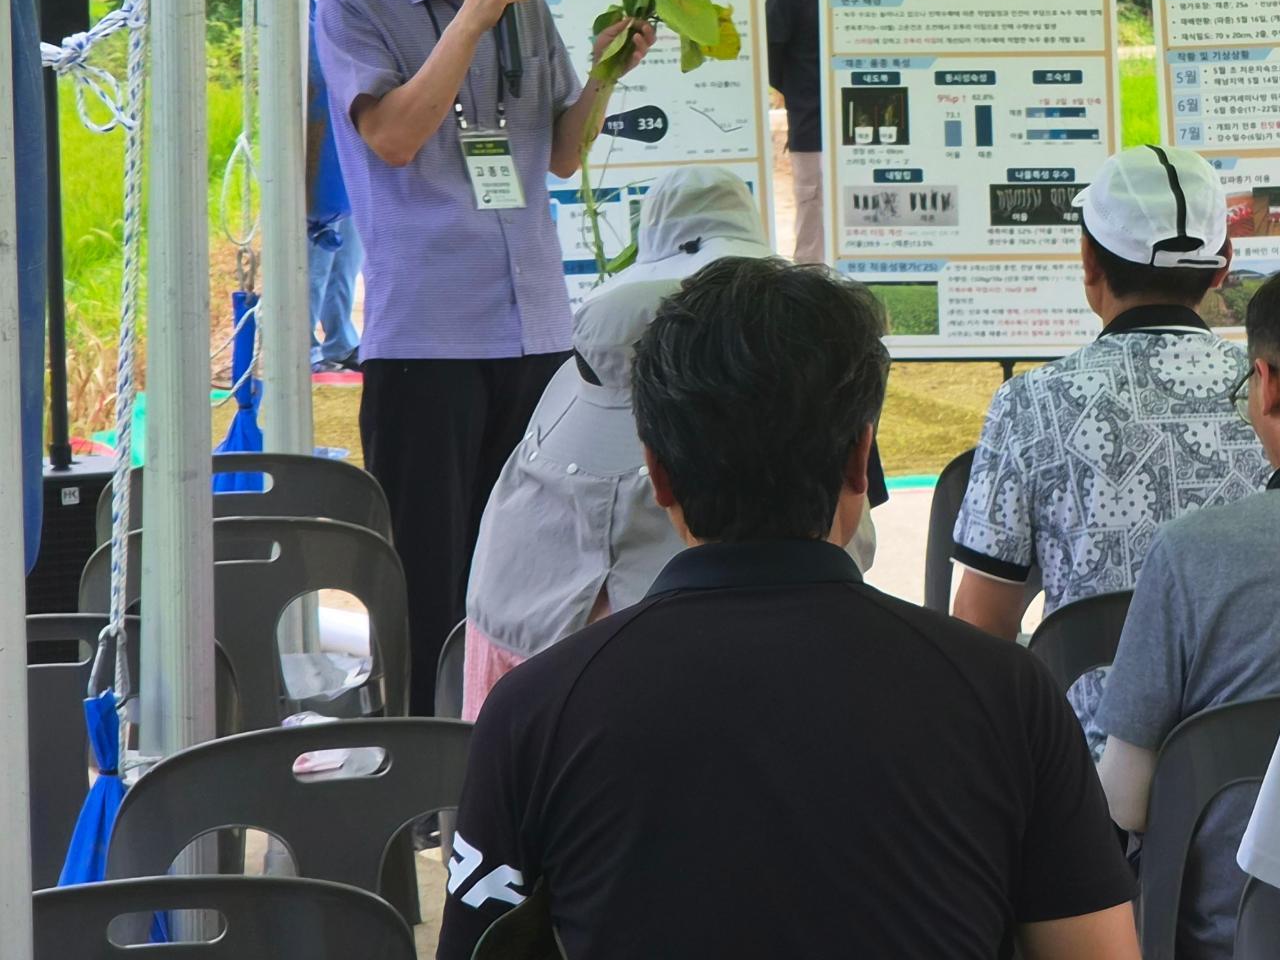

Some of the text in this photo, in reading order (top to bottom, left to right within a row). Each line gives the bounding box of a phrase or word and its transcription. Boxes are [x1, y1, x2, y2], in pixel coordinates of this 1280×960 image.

[1236, 16, 1248, 24] 5월
[1178, 50, 1249, 62] 작황 및 기상상황
[892, 58, 911, 68] 특성
[1213, 66, 1226, 74] 5월
[1176, 70, 1196, 84] 5월
[1214, 76, 1245, 85] 해남지역
[1248, 76, 1259, 84] 5월
[1177, 98, 1198, 112] 6월
[1213, 106, 1226, 114] 6월
[637, 118, 663, 130] 334
[1217, 122, 1238, 131] 개화기
[1242, 122, 1256, 130] 전후
[1180, 127, 1200, 140] 7월
[1255, 174, 1270, 183] 이용
[848, 263, 865, 272] 현장
